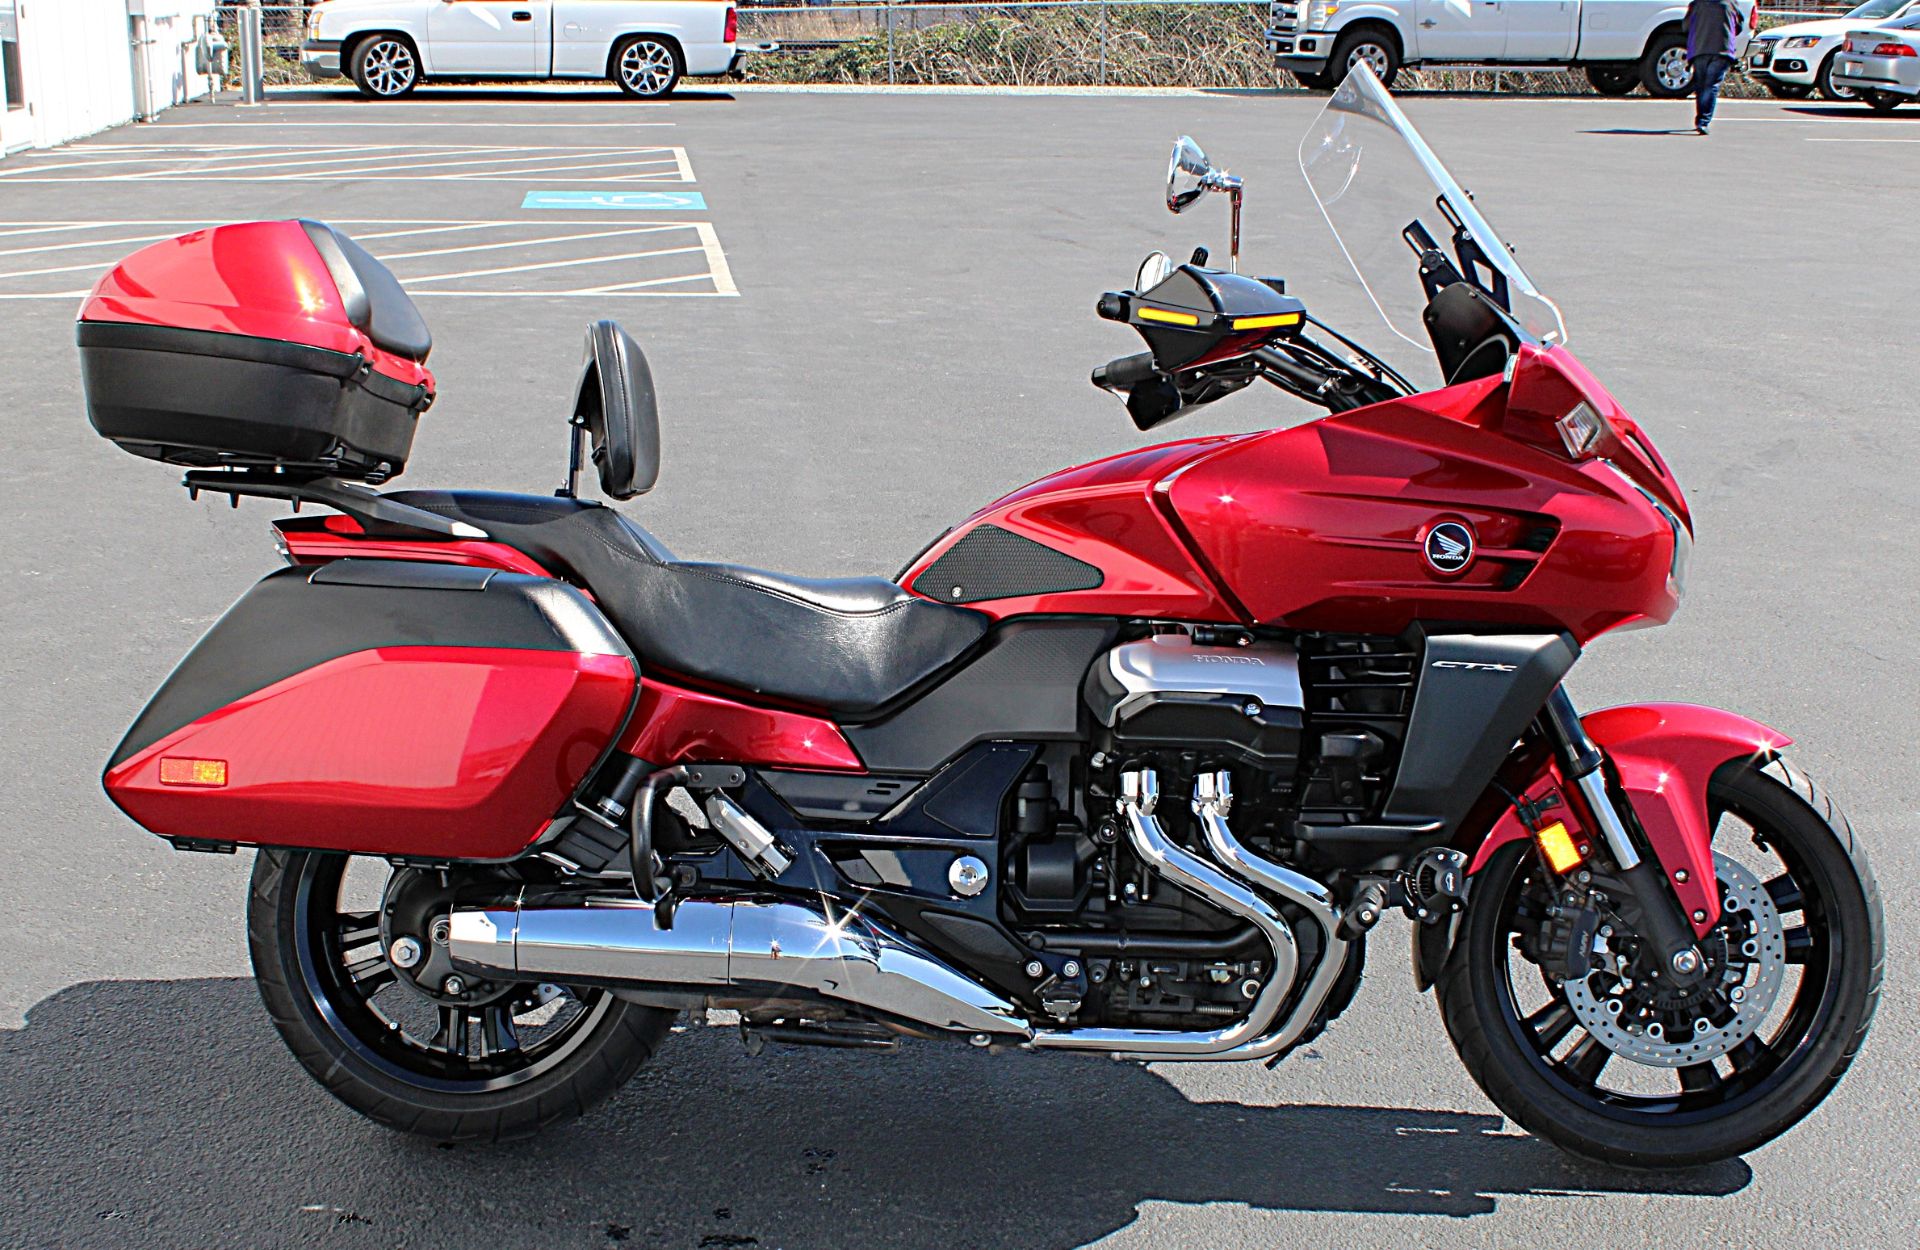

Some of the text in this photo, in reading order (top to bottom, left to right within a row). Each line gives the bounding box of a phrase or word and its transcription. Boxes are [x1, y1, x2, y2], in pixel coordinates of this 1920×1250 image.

[1432, 553, 1465, 561] HONDA
[1192, 654, 1266, 666] HONDA
[1431, 660, 1518, 672] CTX
